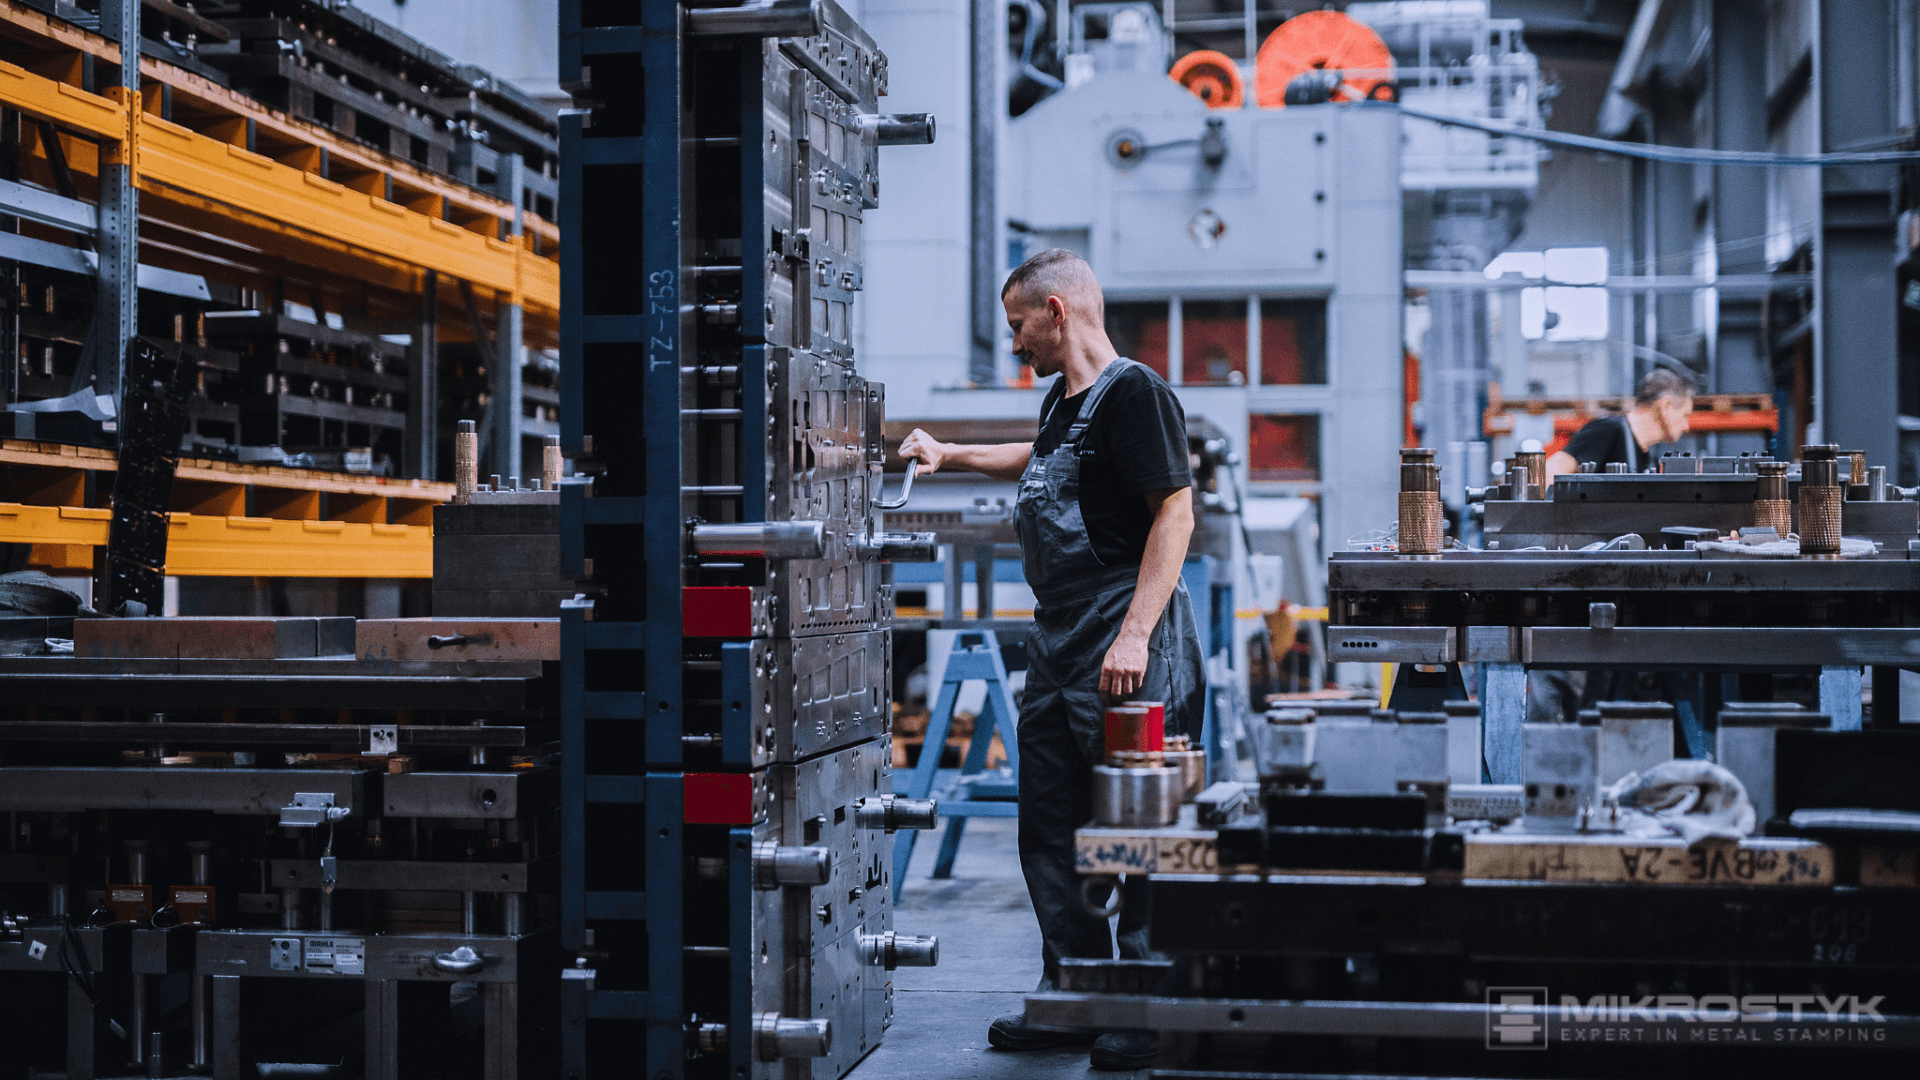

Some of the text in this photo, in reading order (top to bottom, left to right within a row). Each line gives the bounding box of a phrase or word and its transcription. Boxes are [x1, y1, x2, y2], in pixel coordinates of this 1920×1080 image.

[648, 269, 675, 372] TZ-753
[1619, 846, 1756, 881] BVE-2A
[309, 940, 334, 948] MAHLE
